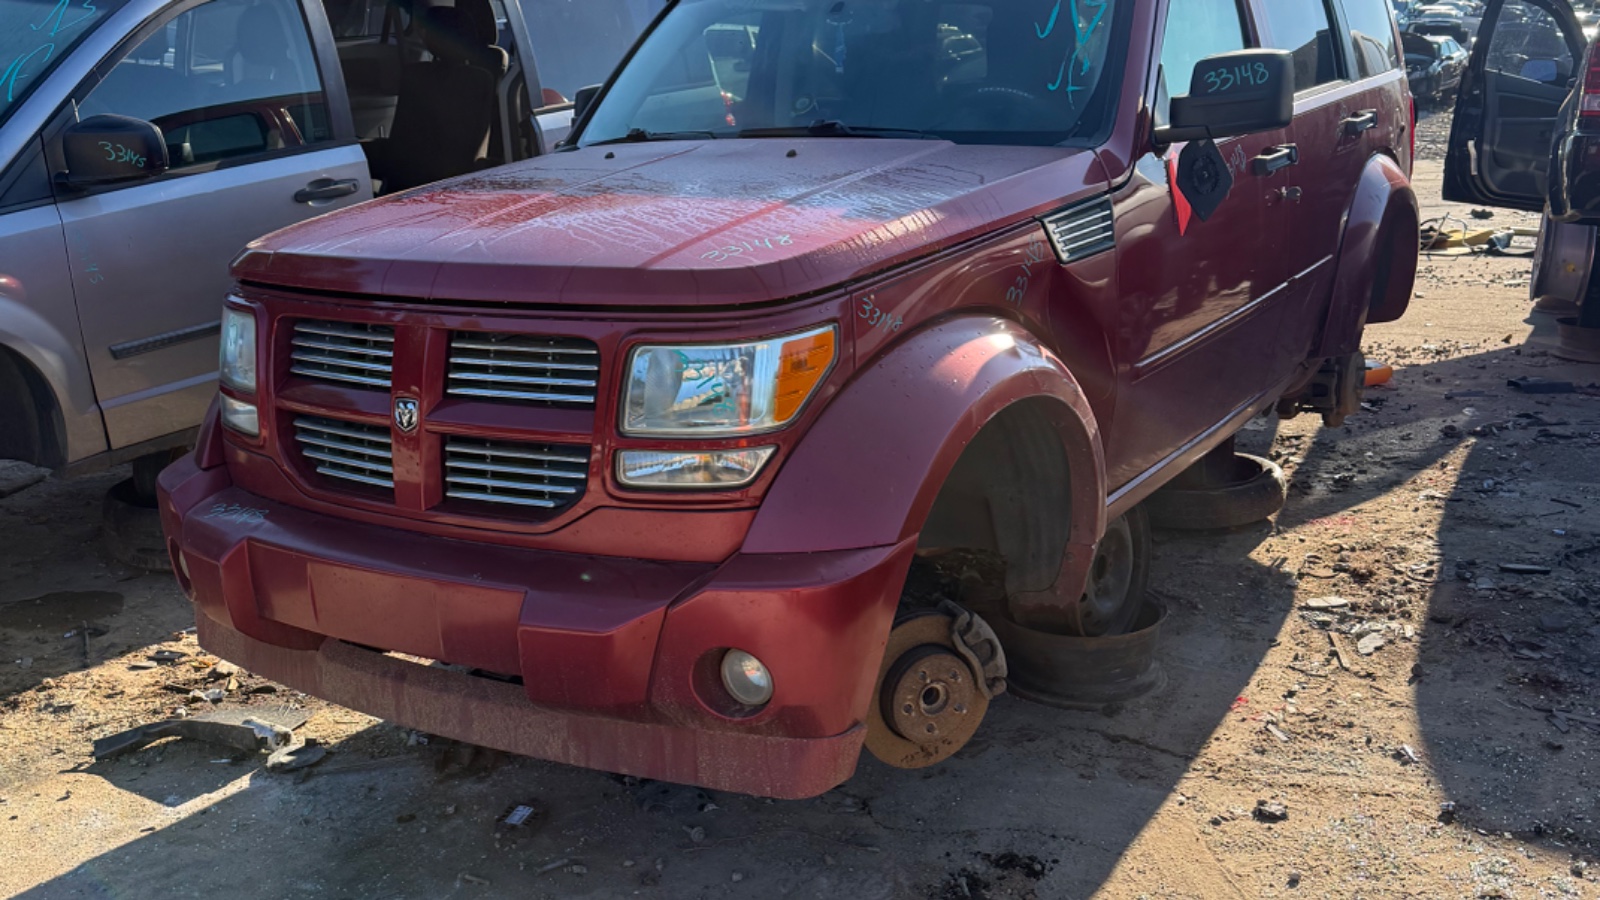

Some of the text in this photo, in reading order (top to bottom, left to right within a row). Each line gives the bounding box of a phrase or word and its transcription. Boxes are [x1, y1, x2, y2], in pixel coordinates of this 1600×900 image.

[1204, 62, 1269, 92] 33148
[98, 141, 147, 168] 33145
[701, 234, 793, 262] 33148
[857, 297, 904, 333] 33148
